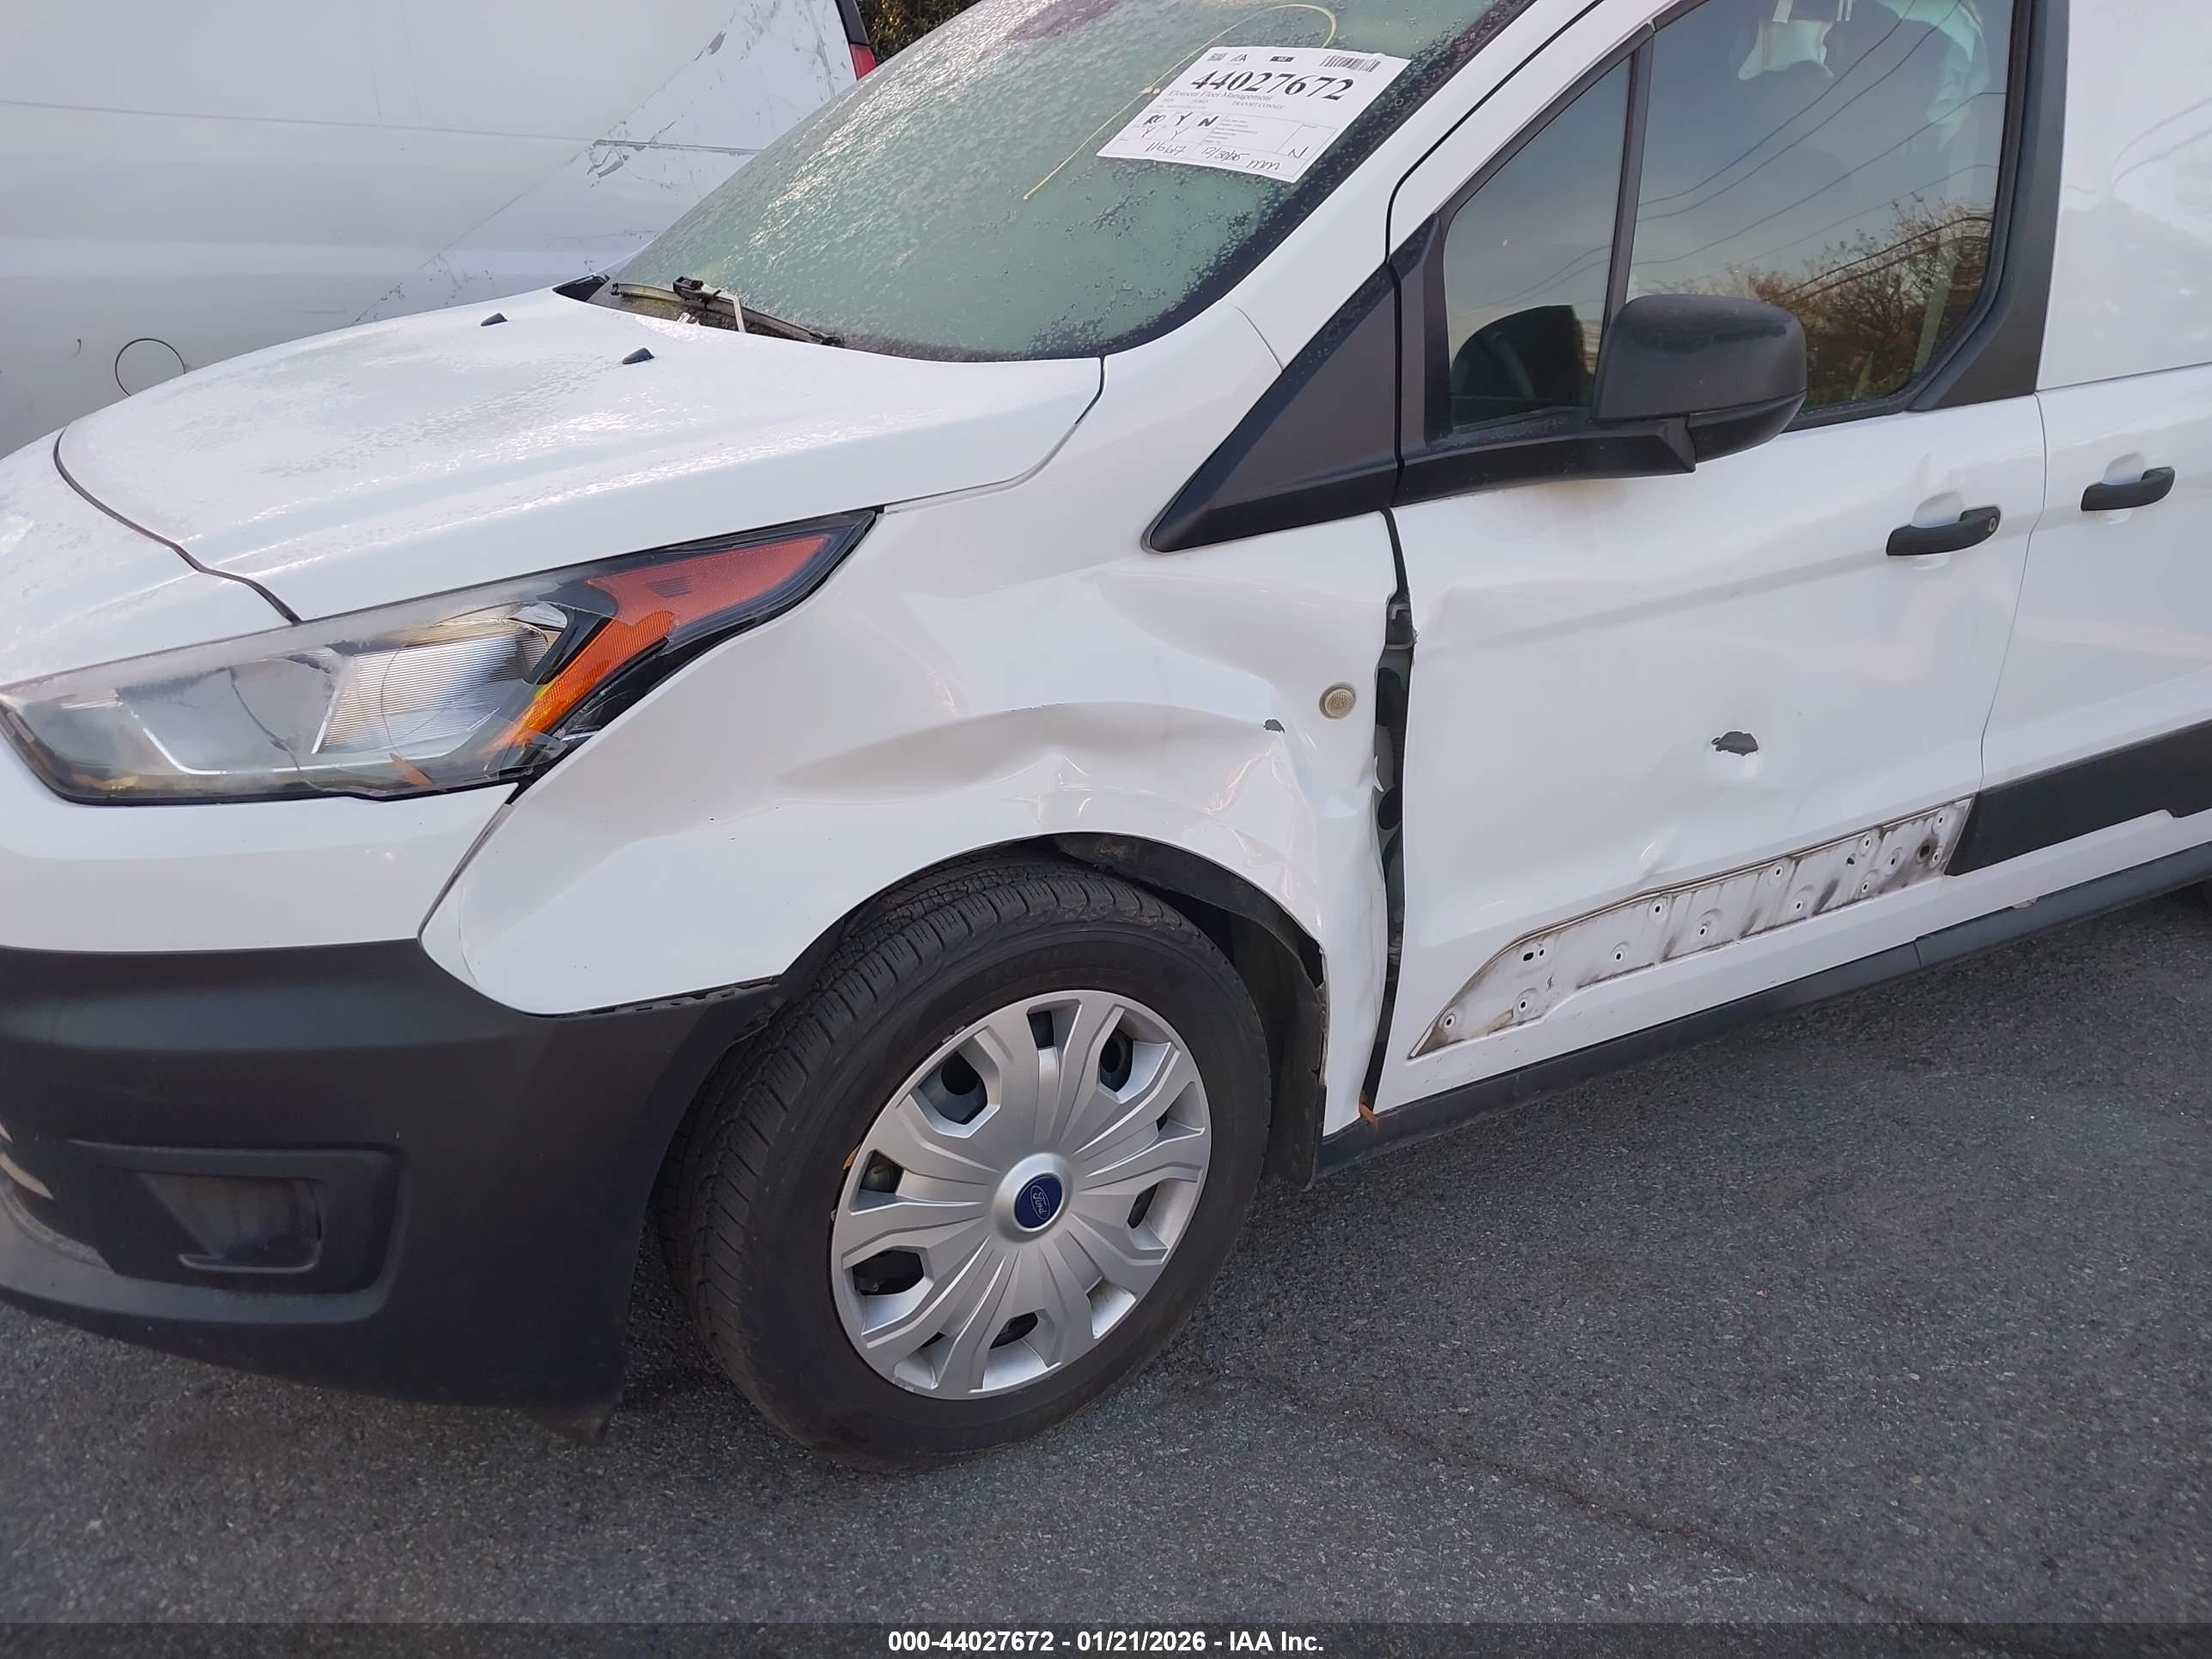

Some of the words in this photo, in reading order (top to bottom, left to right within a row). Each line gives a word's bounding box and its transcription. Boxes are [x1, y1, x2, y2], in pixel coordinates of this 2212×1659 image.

[1191, 70, 1355, 100] 44027672
[1221, 92, 1273, 101] Management
[1175, 112, 1194, 127] Y
[1197, 115, 1220, 127] N
[1288, 146, 1310, 159] N
[1032, 1192, 1048, 1215] Ford
